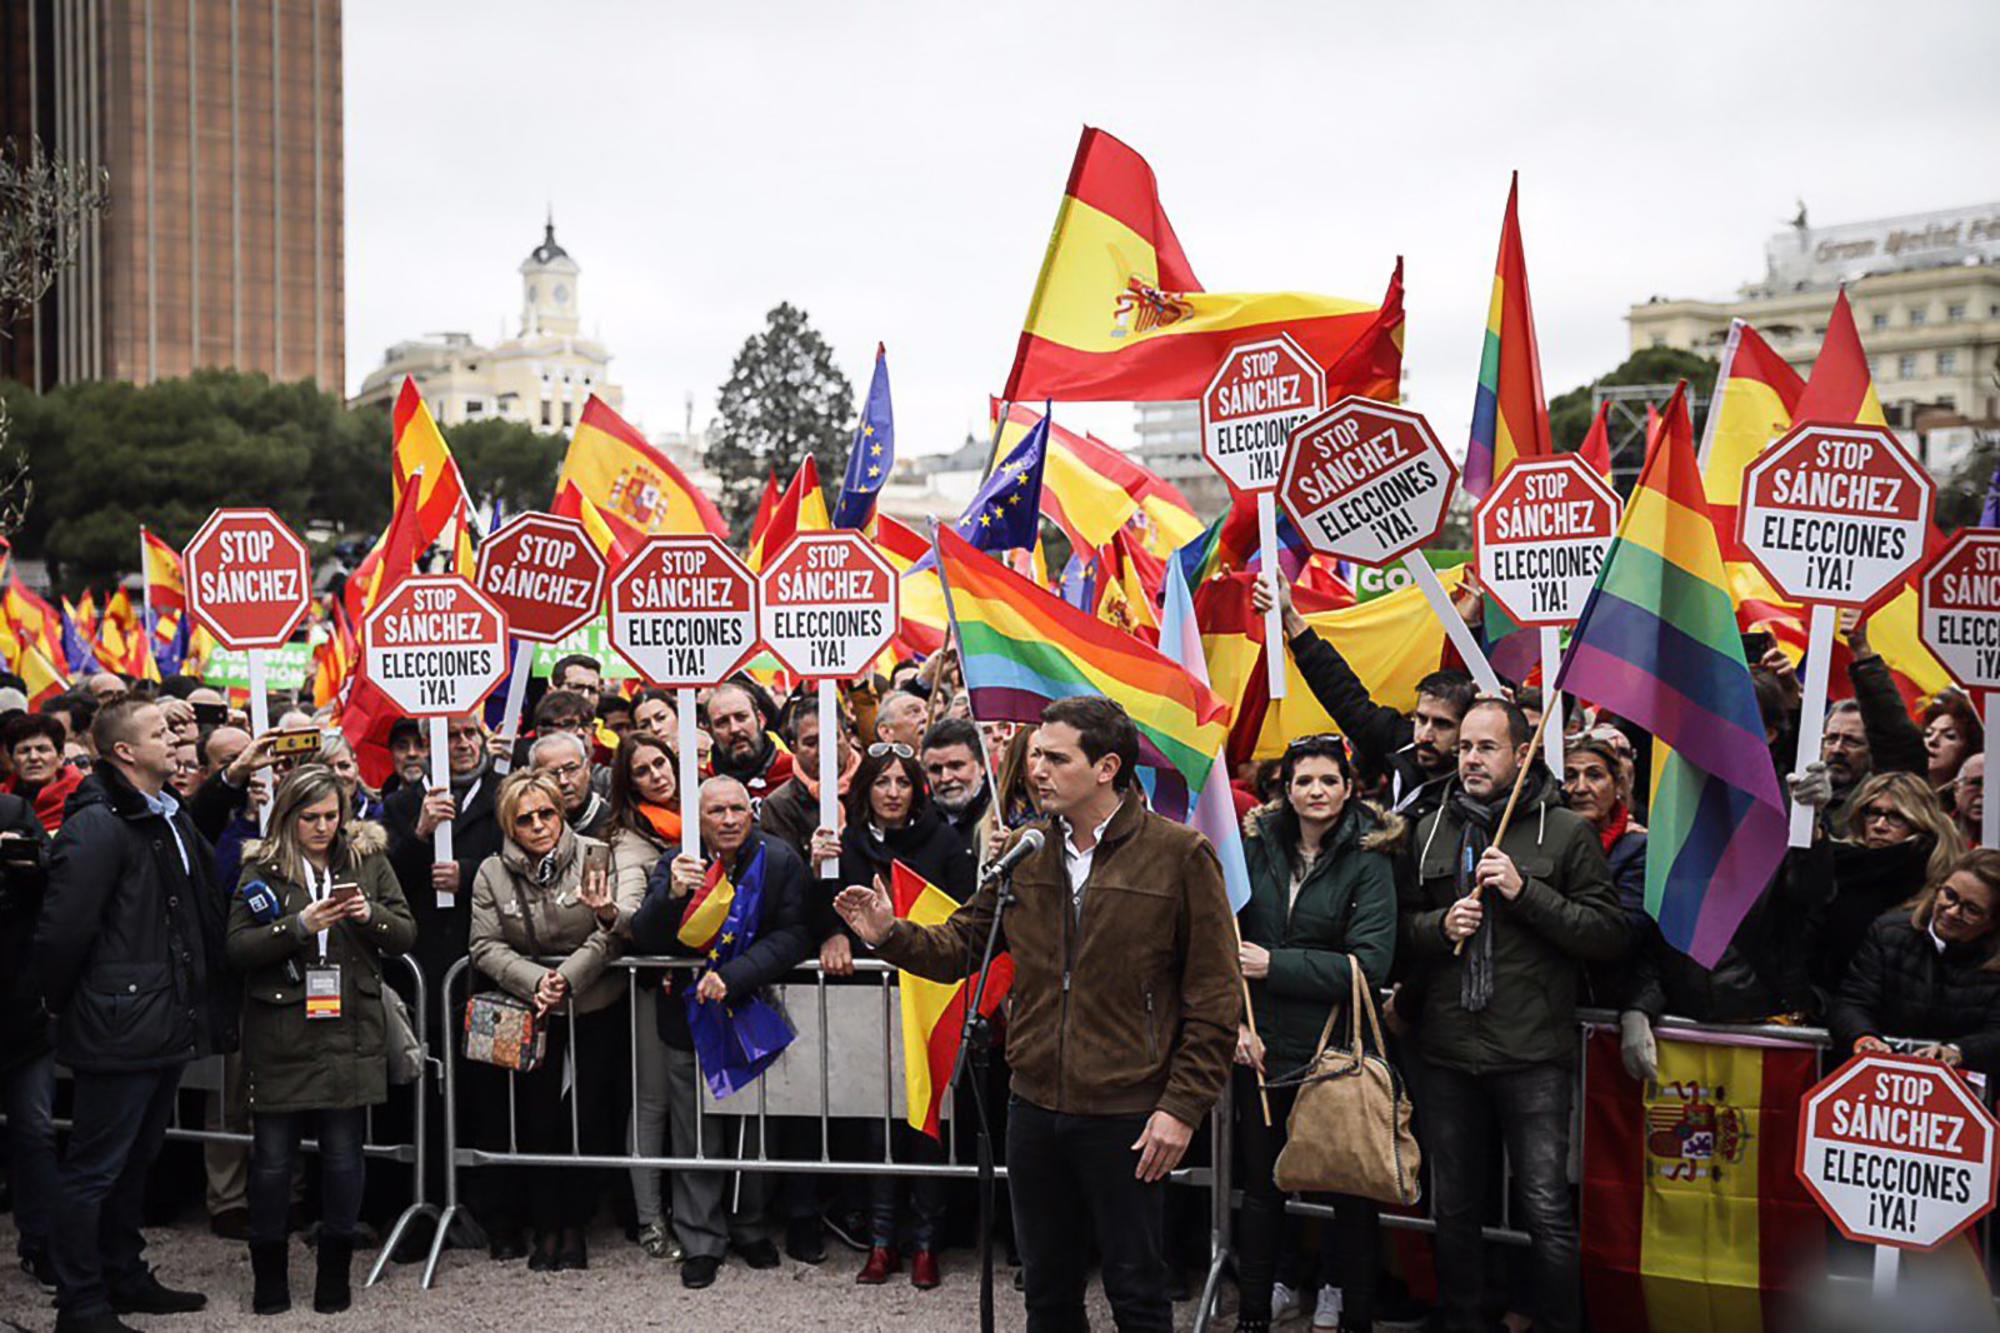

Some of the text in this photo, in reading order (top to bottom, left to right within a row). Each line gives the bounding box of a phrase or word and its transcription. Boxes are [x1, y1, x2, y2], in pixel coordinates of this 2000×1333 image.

[1242, 351, 1278, 378] STOP
[1219, 374, 1301, 416] SÁNCHEZ
[1218, 414, 1309, 455] ELECCION
[1313, 418, 1359, 459] STOP
[1249, 451, 1280, 480] ¡YA!
[1298, 427, 1410, 505] SÁNCHEZ
[1816, 440, 1873, 470] STOP
[1316, 461, 1438, 542] ELECCIONES
[1525, 473, 1569, 500] STOP
[1772, 461, 1902, 514] SÁNCHEZ
[1370, 508, 1418, 549] ¡YA!
[1496, 498, 1595, 539] SÁNCHEZ
[219, 530, 275, 564] STOP
[517, 534, 576, 570] STOP
[1762, 516, 1907, 560] ELECCIONES
[662, 551, 707, 575] STOP
[807, 545, 850, 569] STOP
[1494, 545, 1604, 581] ELECCIONES
[1806, 555, 1854, 592] ¡YA!
[1975, 546, 2000, 571] ST
[201, 564, 299, 604] SÁNCHEZ
[413, 588, 457, 611] STOP
[487, 560, 592, 609] SÁNCHEZ
[631, 572, 733, 609] SÁNCHEZ
[778, 565, 874, 601] SÁNCHEZ
[1531, 581, 1568, 612] ¡YA!
[383, 608, 483, 643] SÁNCHEZ
[629, 618, 742, 646] ELECCIONES
[775, 609, 882, 638] ELECCIONES
[382, 650, 491, 679] ELECCIONES
[668, 649, 705, 676] ¡YA!
[811, 641, 846, 666] ¡YA!
[420, 679, 456, 705] ¡YA!
[1875, 1072, 1934, 1106] STOP
[1831, 1093, 1965, 1154] SÁNCHEZ
[1823, 1147, 1971, 1205] ELECCIONES
[1868, 1192, 1917, 1234] ¡YA!
